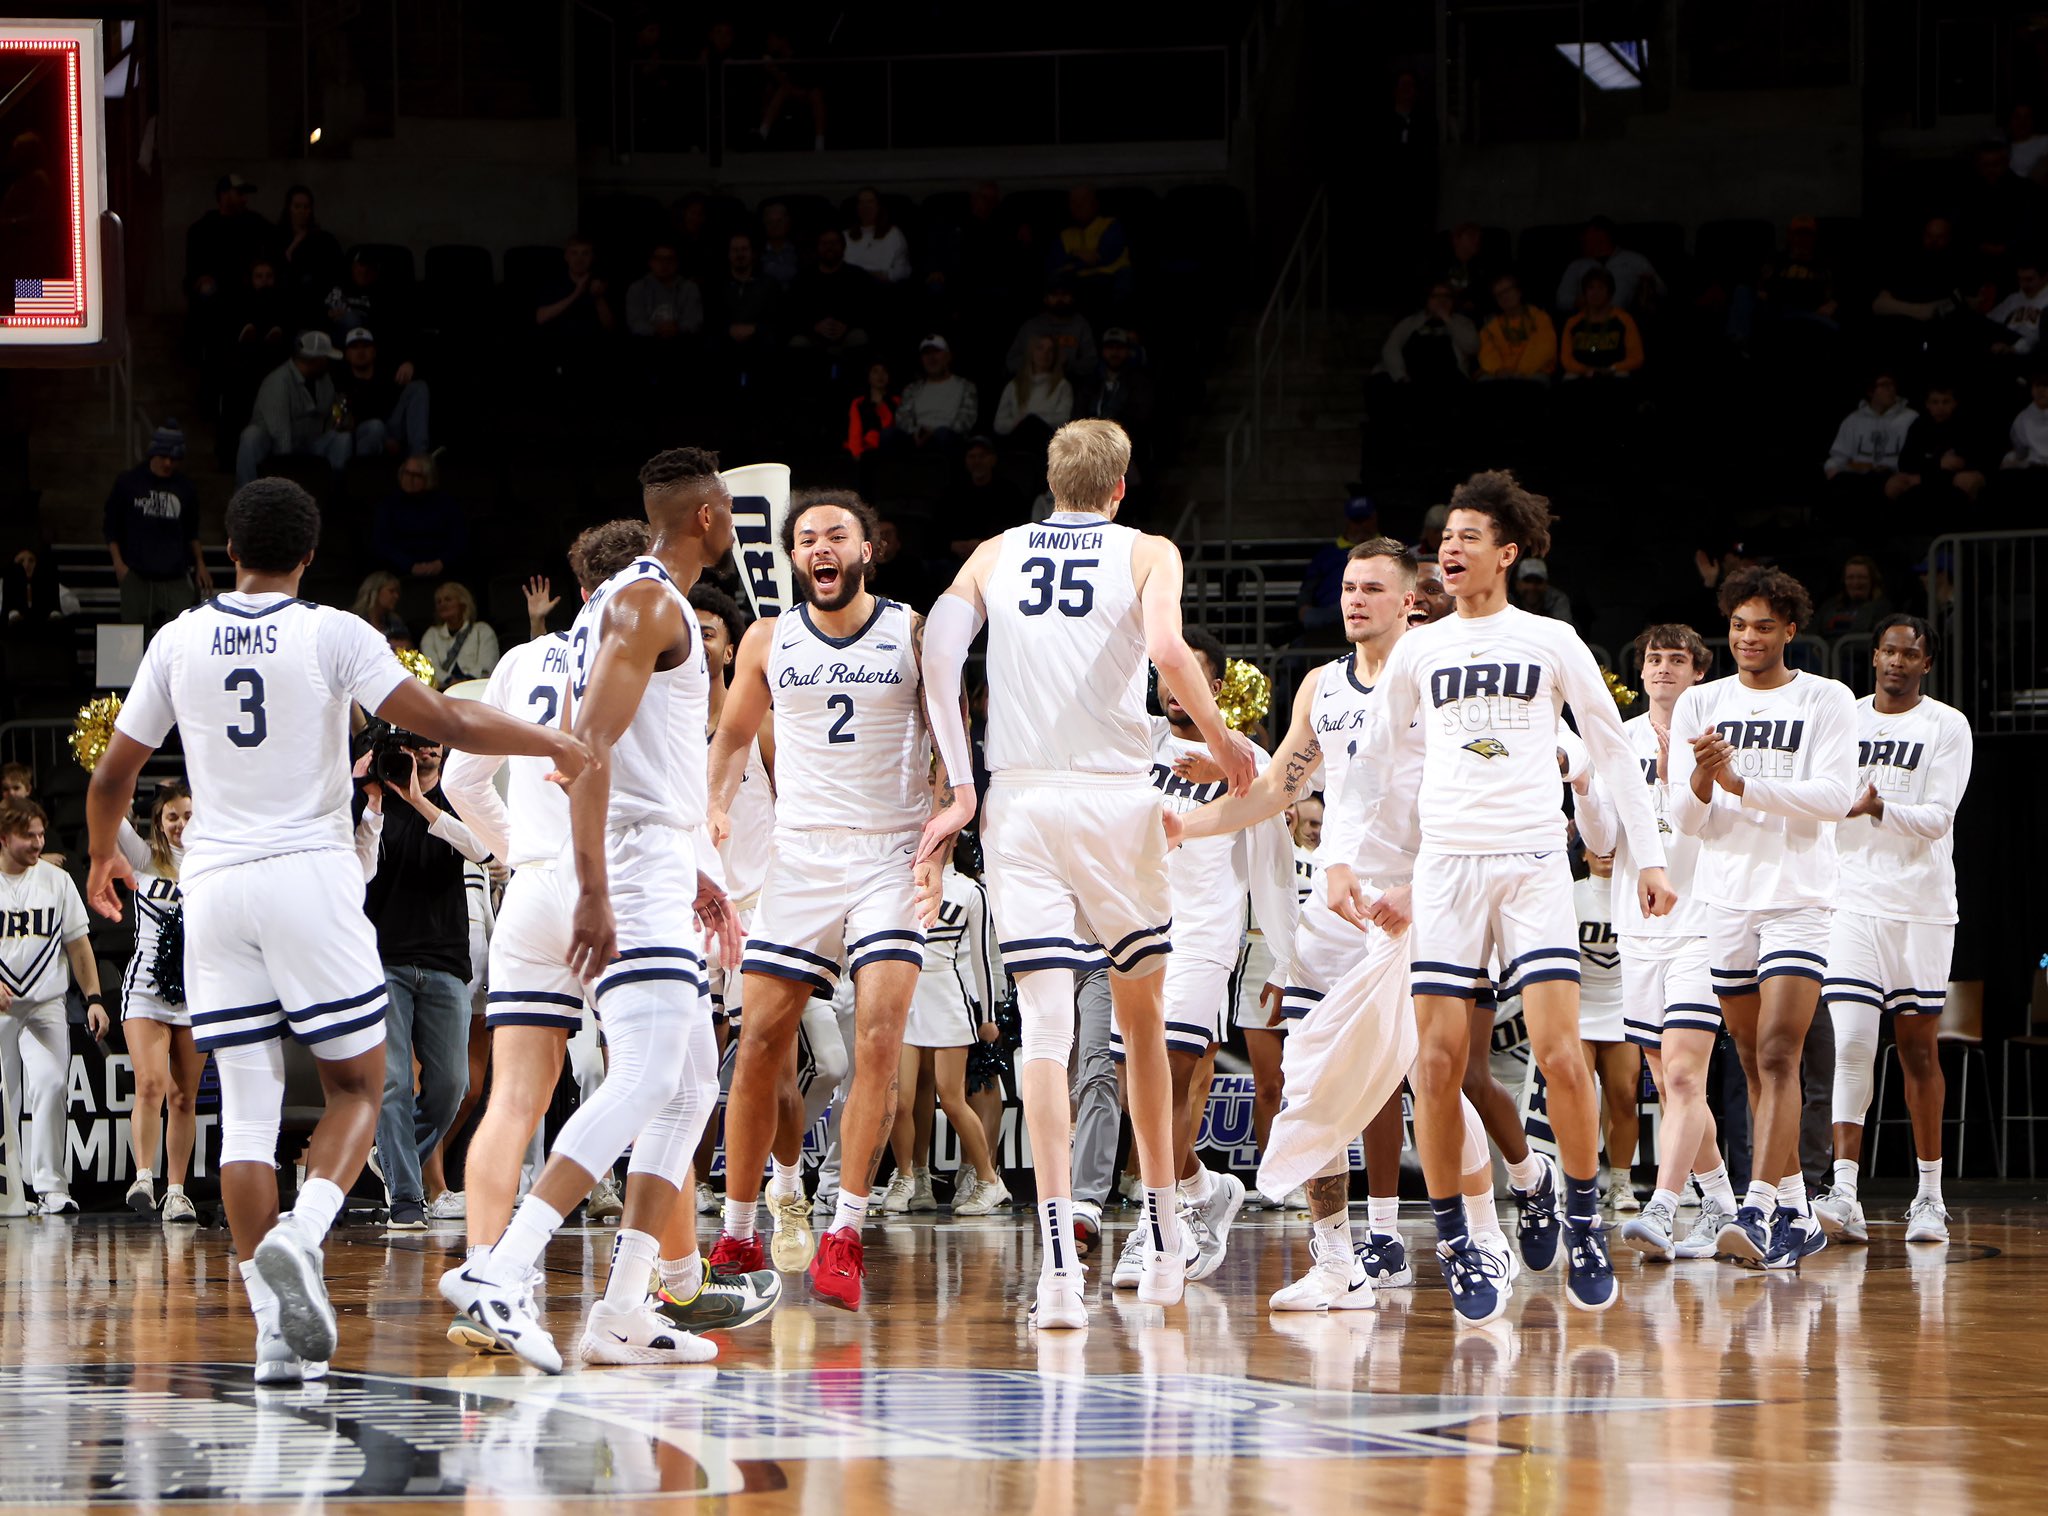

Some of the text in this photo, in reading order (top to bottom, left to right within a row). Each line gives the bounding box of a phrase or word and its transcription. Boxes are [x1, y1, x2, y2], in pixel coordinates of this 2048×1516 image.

[1029, 531, 1103, 550] VANOVER
[1019, 557, 1099, 617] 35
[211, 625, 277, 655] ABMAS
[779, 663, 902, 688] Oral Roberts
[1431, 663, 1541, 709] ORU
[224, 668, 267, 747] 3
[827, 694, 855, 744] 2
[1317, 711, 1349, 734] Oral
[1442, 694, 1530, 735] SOLE
[0, 907, 55, 937] RU
